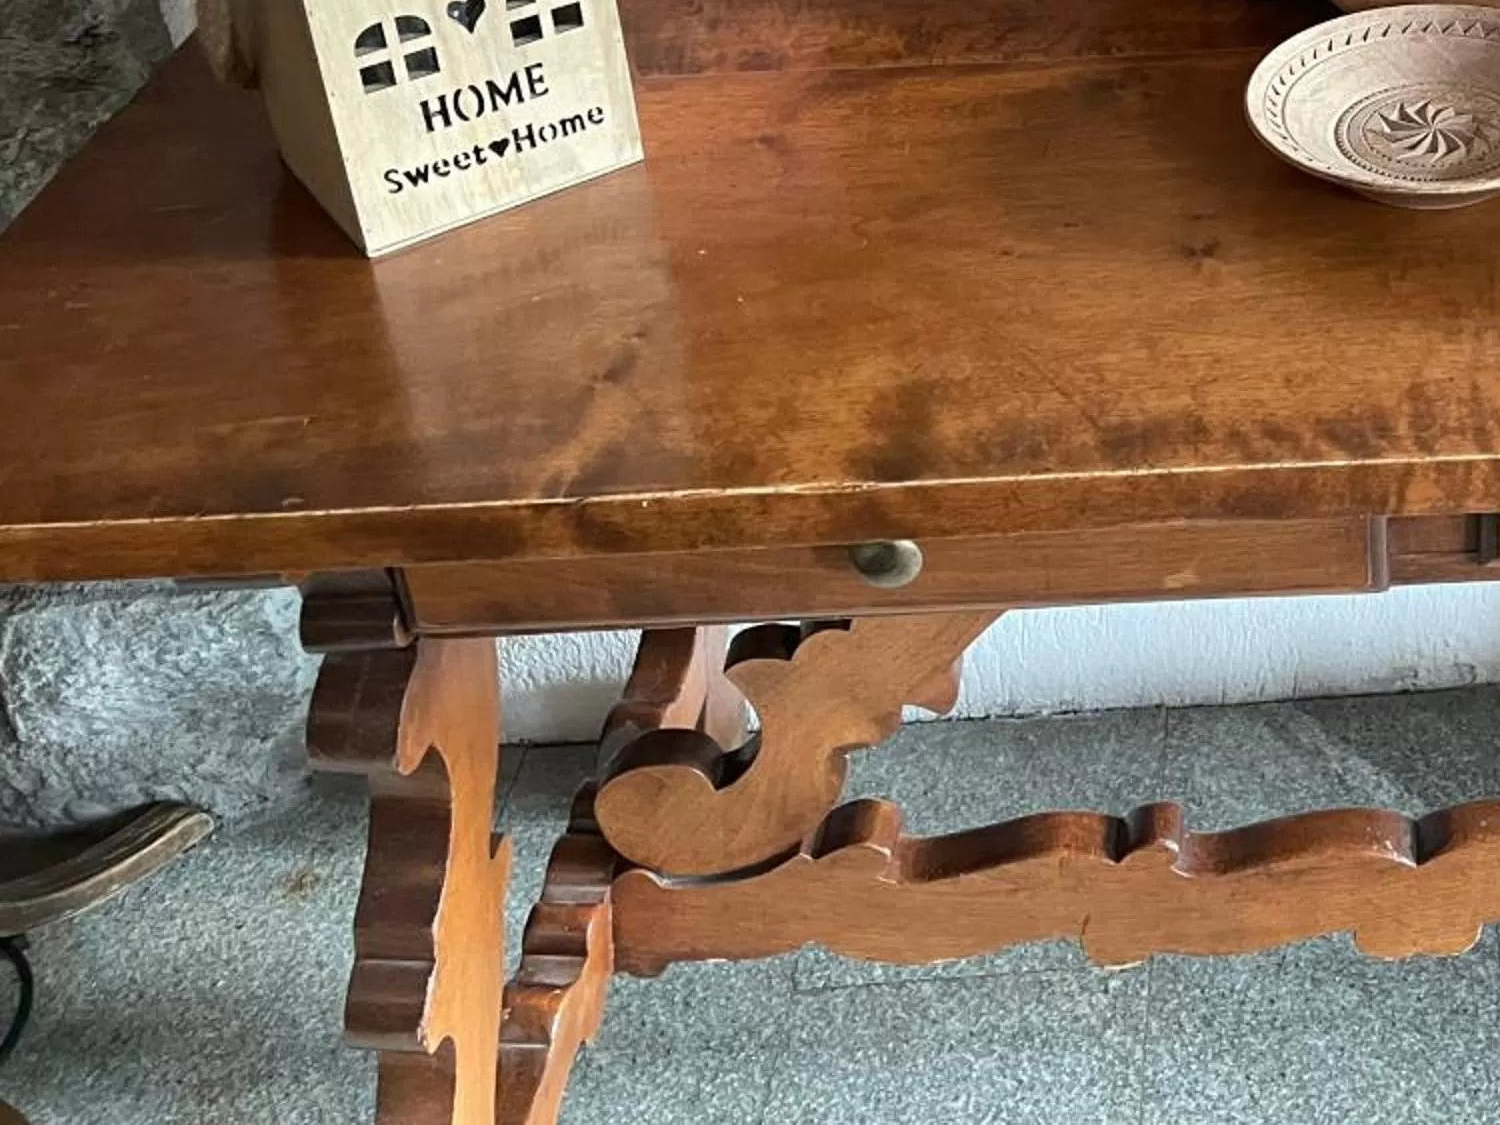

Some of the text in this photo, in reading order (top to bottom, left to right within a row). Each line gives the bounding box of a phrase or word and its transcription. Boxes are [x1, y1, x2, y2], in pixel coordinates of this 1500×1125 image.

[420, 63, 550, 134] HOME
[384, 104, 605, 194] Sweet Home
